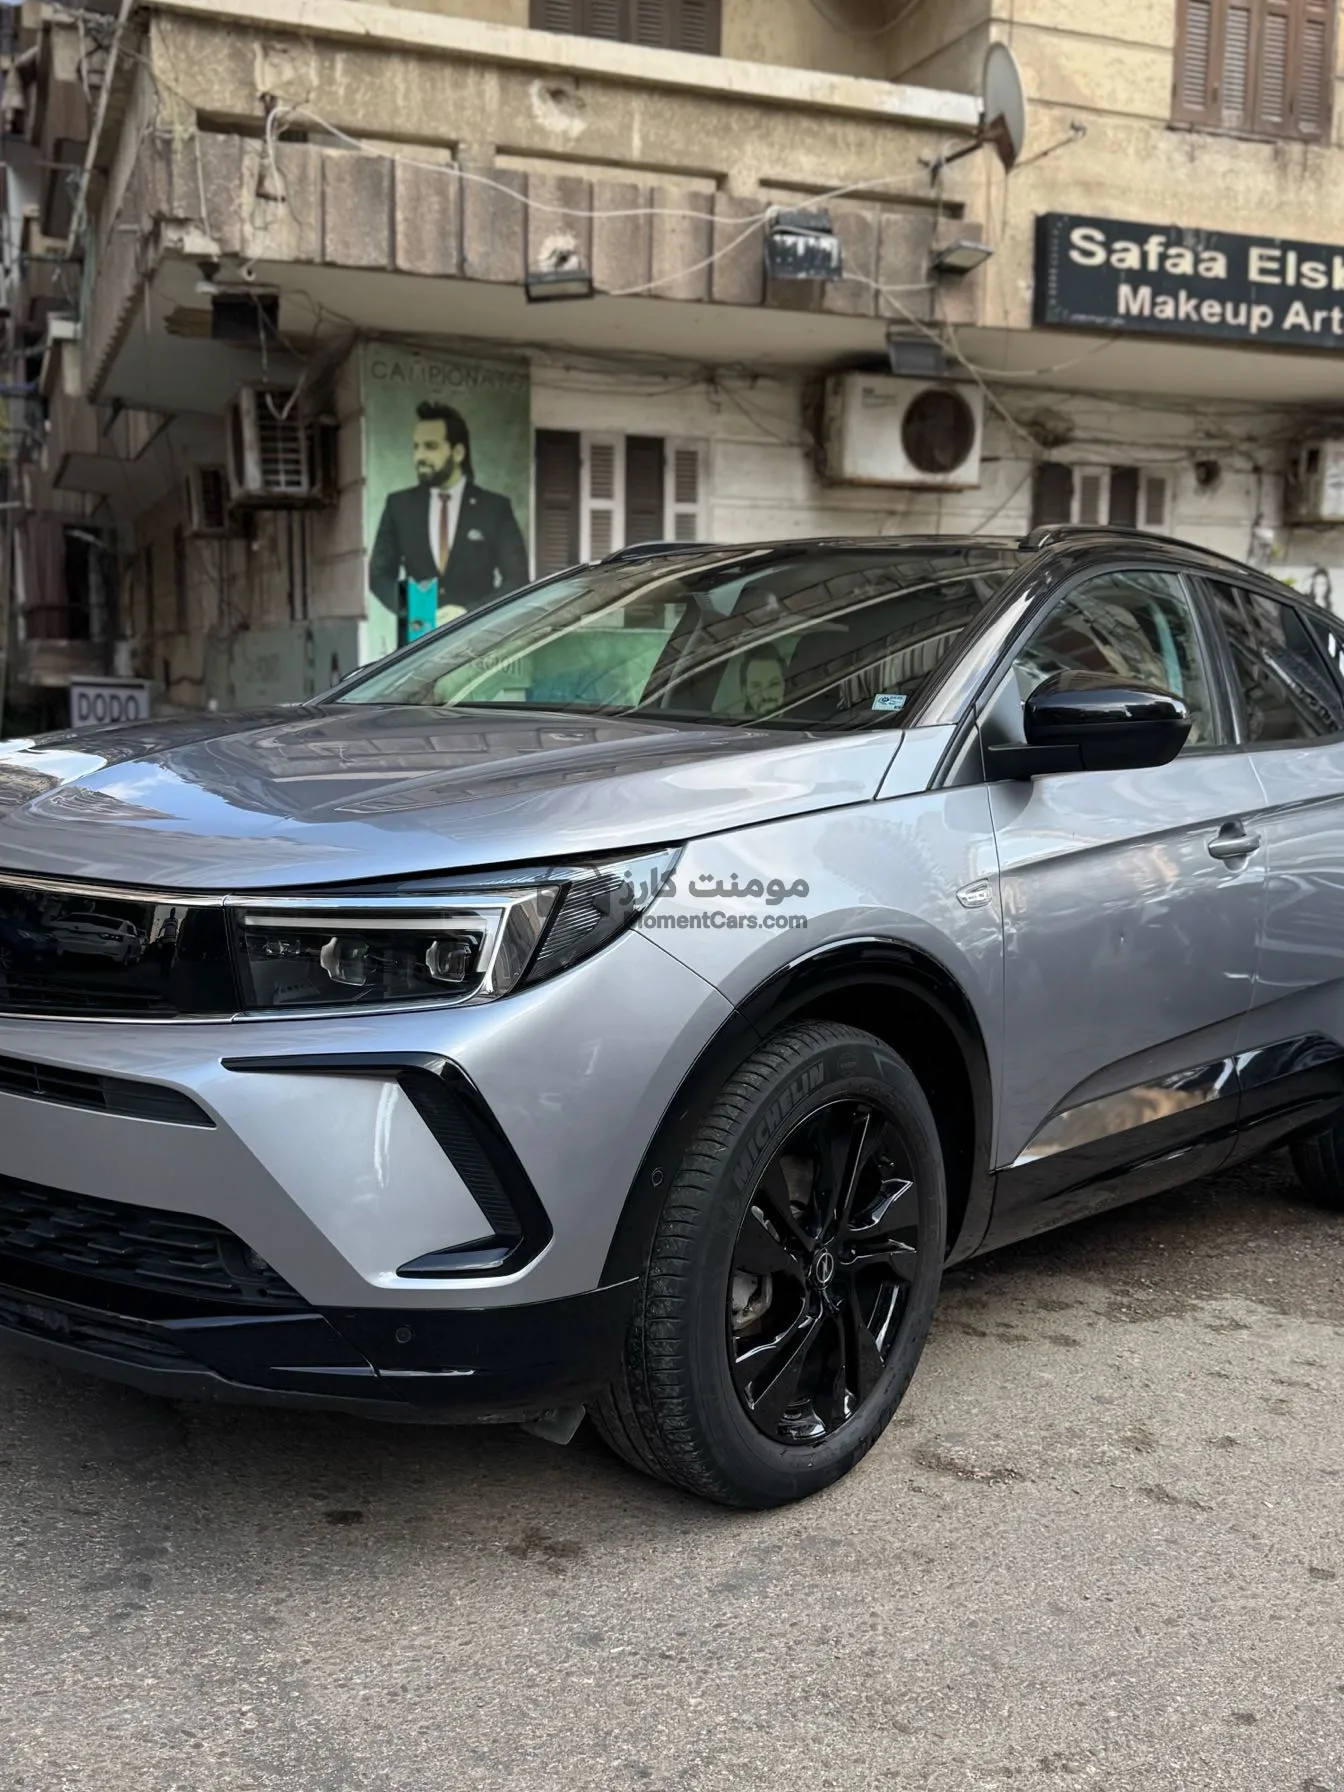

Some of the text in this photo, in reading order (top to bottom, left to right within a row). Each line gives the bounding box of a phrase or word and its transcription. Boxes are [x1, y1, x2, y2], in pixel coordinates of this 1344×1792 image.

[1068, 226, 1228, 280] Safaa
[1117, 283, 1344, 335] Makeup Art
[78, 692, 139, 722] DODO
[731, 1060, 825, 1190] MICHELIN
